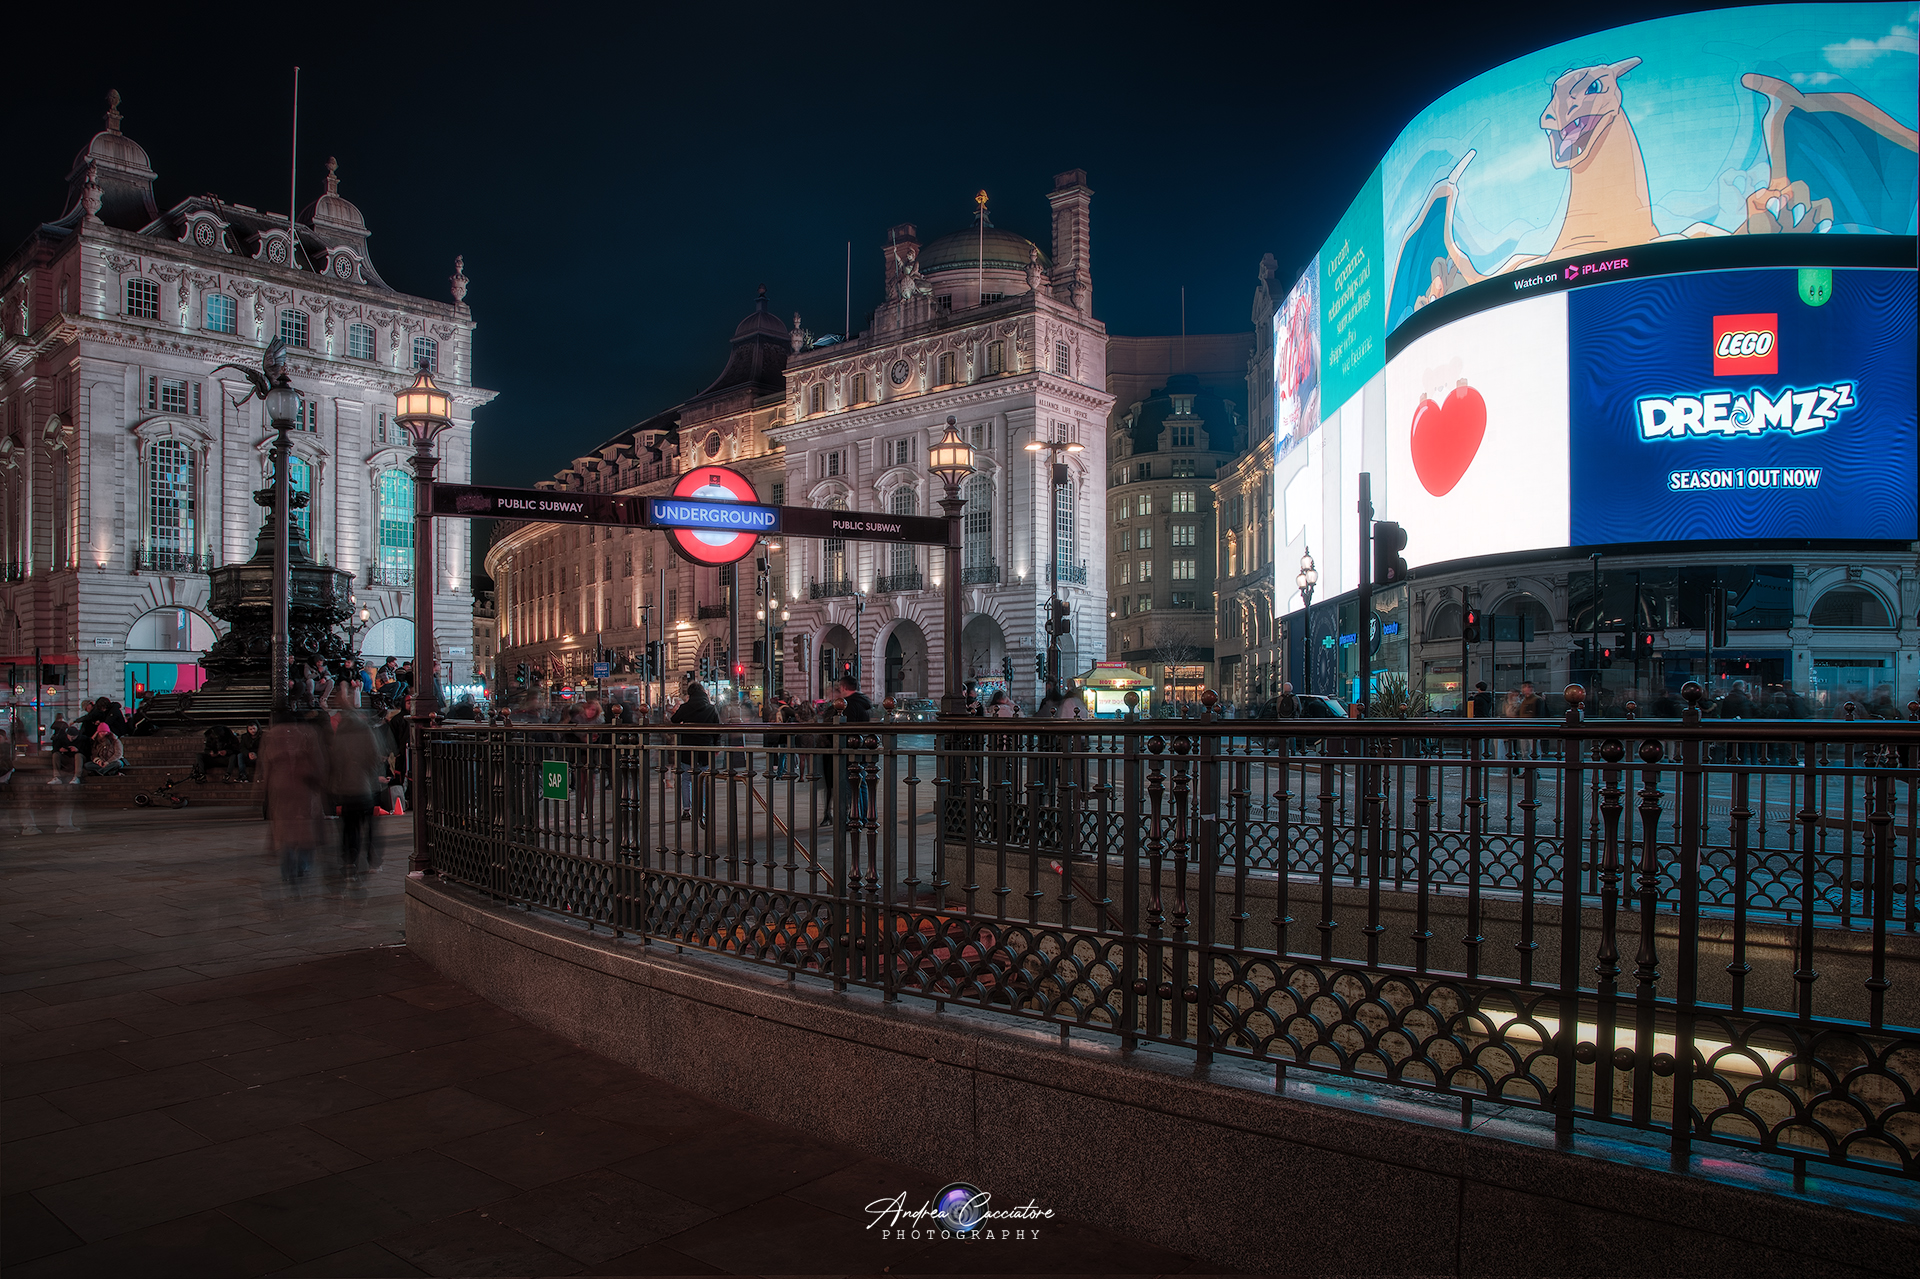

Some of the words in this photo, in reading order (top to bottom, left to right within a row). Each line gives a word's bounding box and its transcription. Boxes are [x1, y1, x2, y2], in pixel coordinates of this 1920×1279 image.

[1513, 275, 1543, 290] Watch
[1545, 273, 1557, 283] on
[1582, 258, 1629, 275] iPLAYER
[1717, 331, 1774, 357] LEGO
[1039, 399, 1059, 411] ALLIANCE
[1062, 406, 1071, 415] LIFE
[1074, 410, 1088, 419] OFFICE
[1670, 470, 1733, 490] SEASON
[1736, 470, 1743, 488] 1
[1749, 470, 1780, 488] OUT
[1783, 469, 1821, 488] NOW
[497, 498, 537, 510] PUBLIC
[539, 500, 584, 513] SUBWAY
[654, 505, 776, 526] UNDERGROUND
[832, 520, 864, 531] PUBLIC
[865, 522, 901, 533] SUBWAY
[1383, 621, 1399, 636] beauty
[548, 772, 562, 788] SAP
